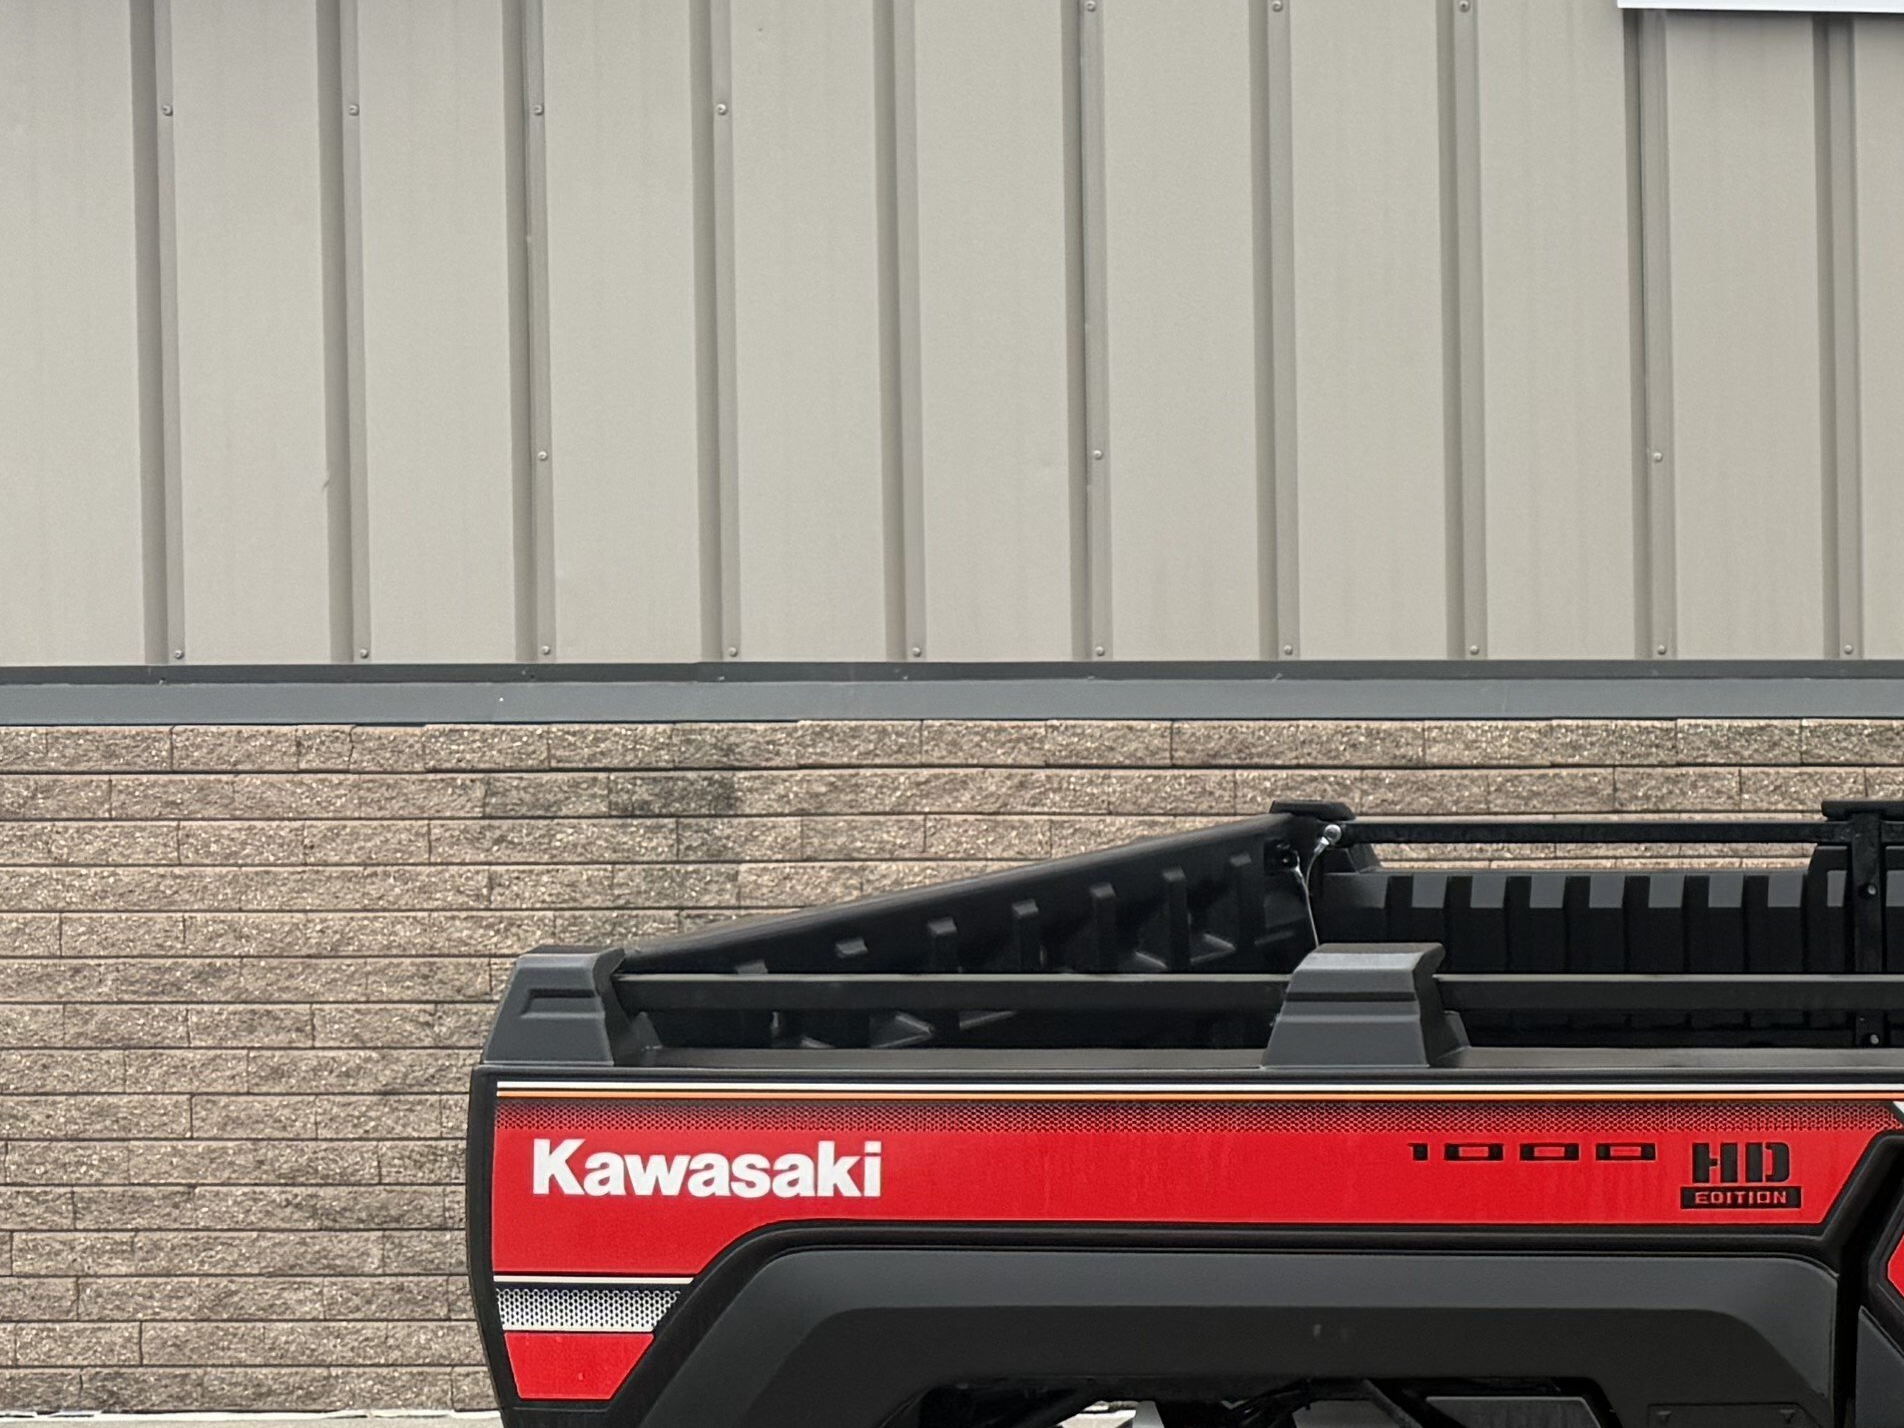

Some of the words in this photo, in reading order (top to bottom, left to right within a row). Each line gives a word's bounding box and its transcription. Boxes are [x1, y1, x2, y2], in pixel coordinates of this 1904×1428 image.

[532, 1137, 882, 1199] Kawasaki
[1408, 1142, 1657, 1162] 1000
[1691, 1141, 1791, 1184] HD
[1693, 1189, 1789, 1206] EDITION
